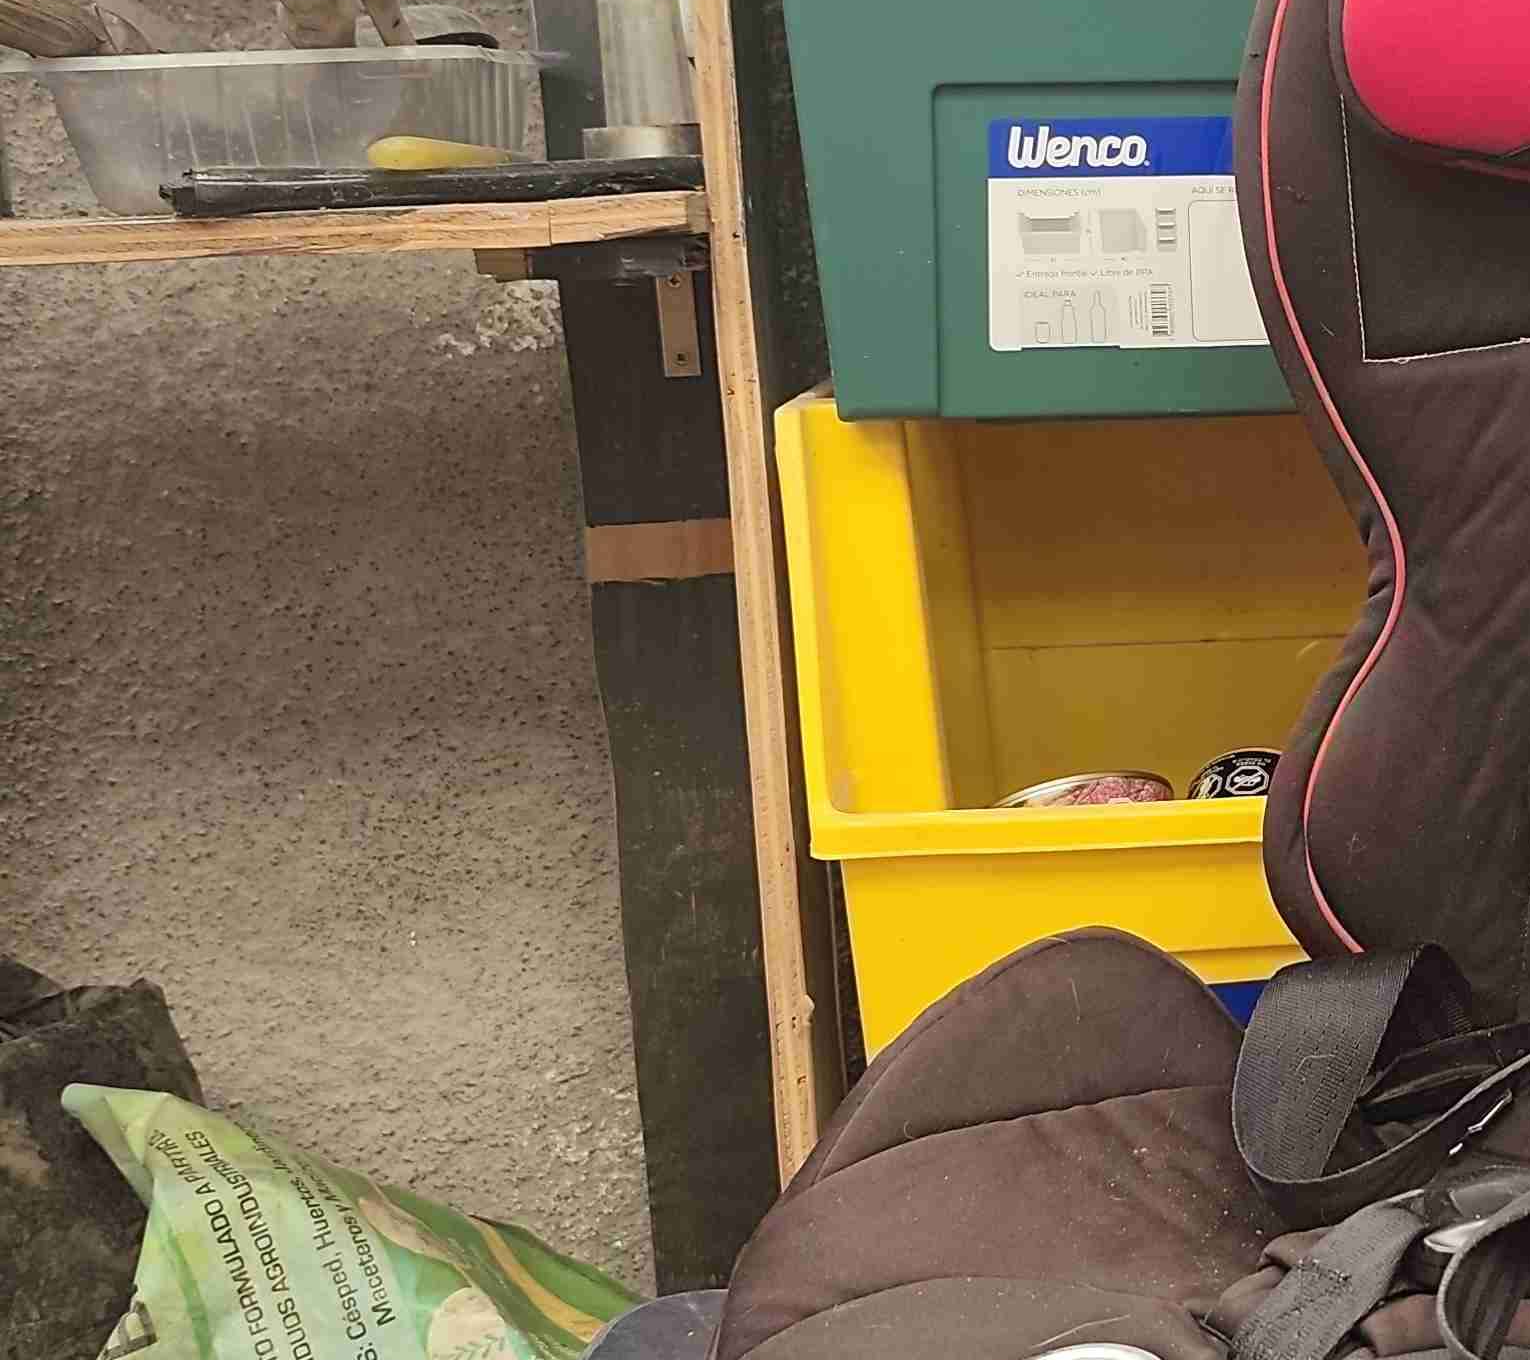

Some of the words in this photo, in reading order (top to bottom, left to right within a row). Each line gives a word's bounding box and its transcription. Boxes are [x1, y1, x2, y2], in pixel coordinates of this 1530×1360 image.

[1007, 125, 1147, 169] Wenco
[156, 1136, 203, 1183] PARTIR
[194, 1182, 216, 1197] A
[186, 1129, 290, 1294] AGROINDUSTRIALES
[203, 1200, 268, 1336] FORMULADO
[319, 1252, 360, 1340] Césped,
[342, 1217, 395, 1326] Maceteros
